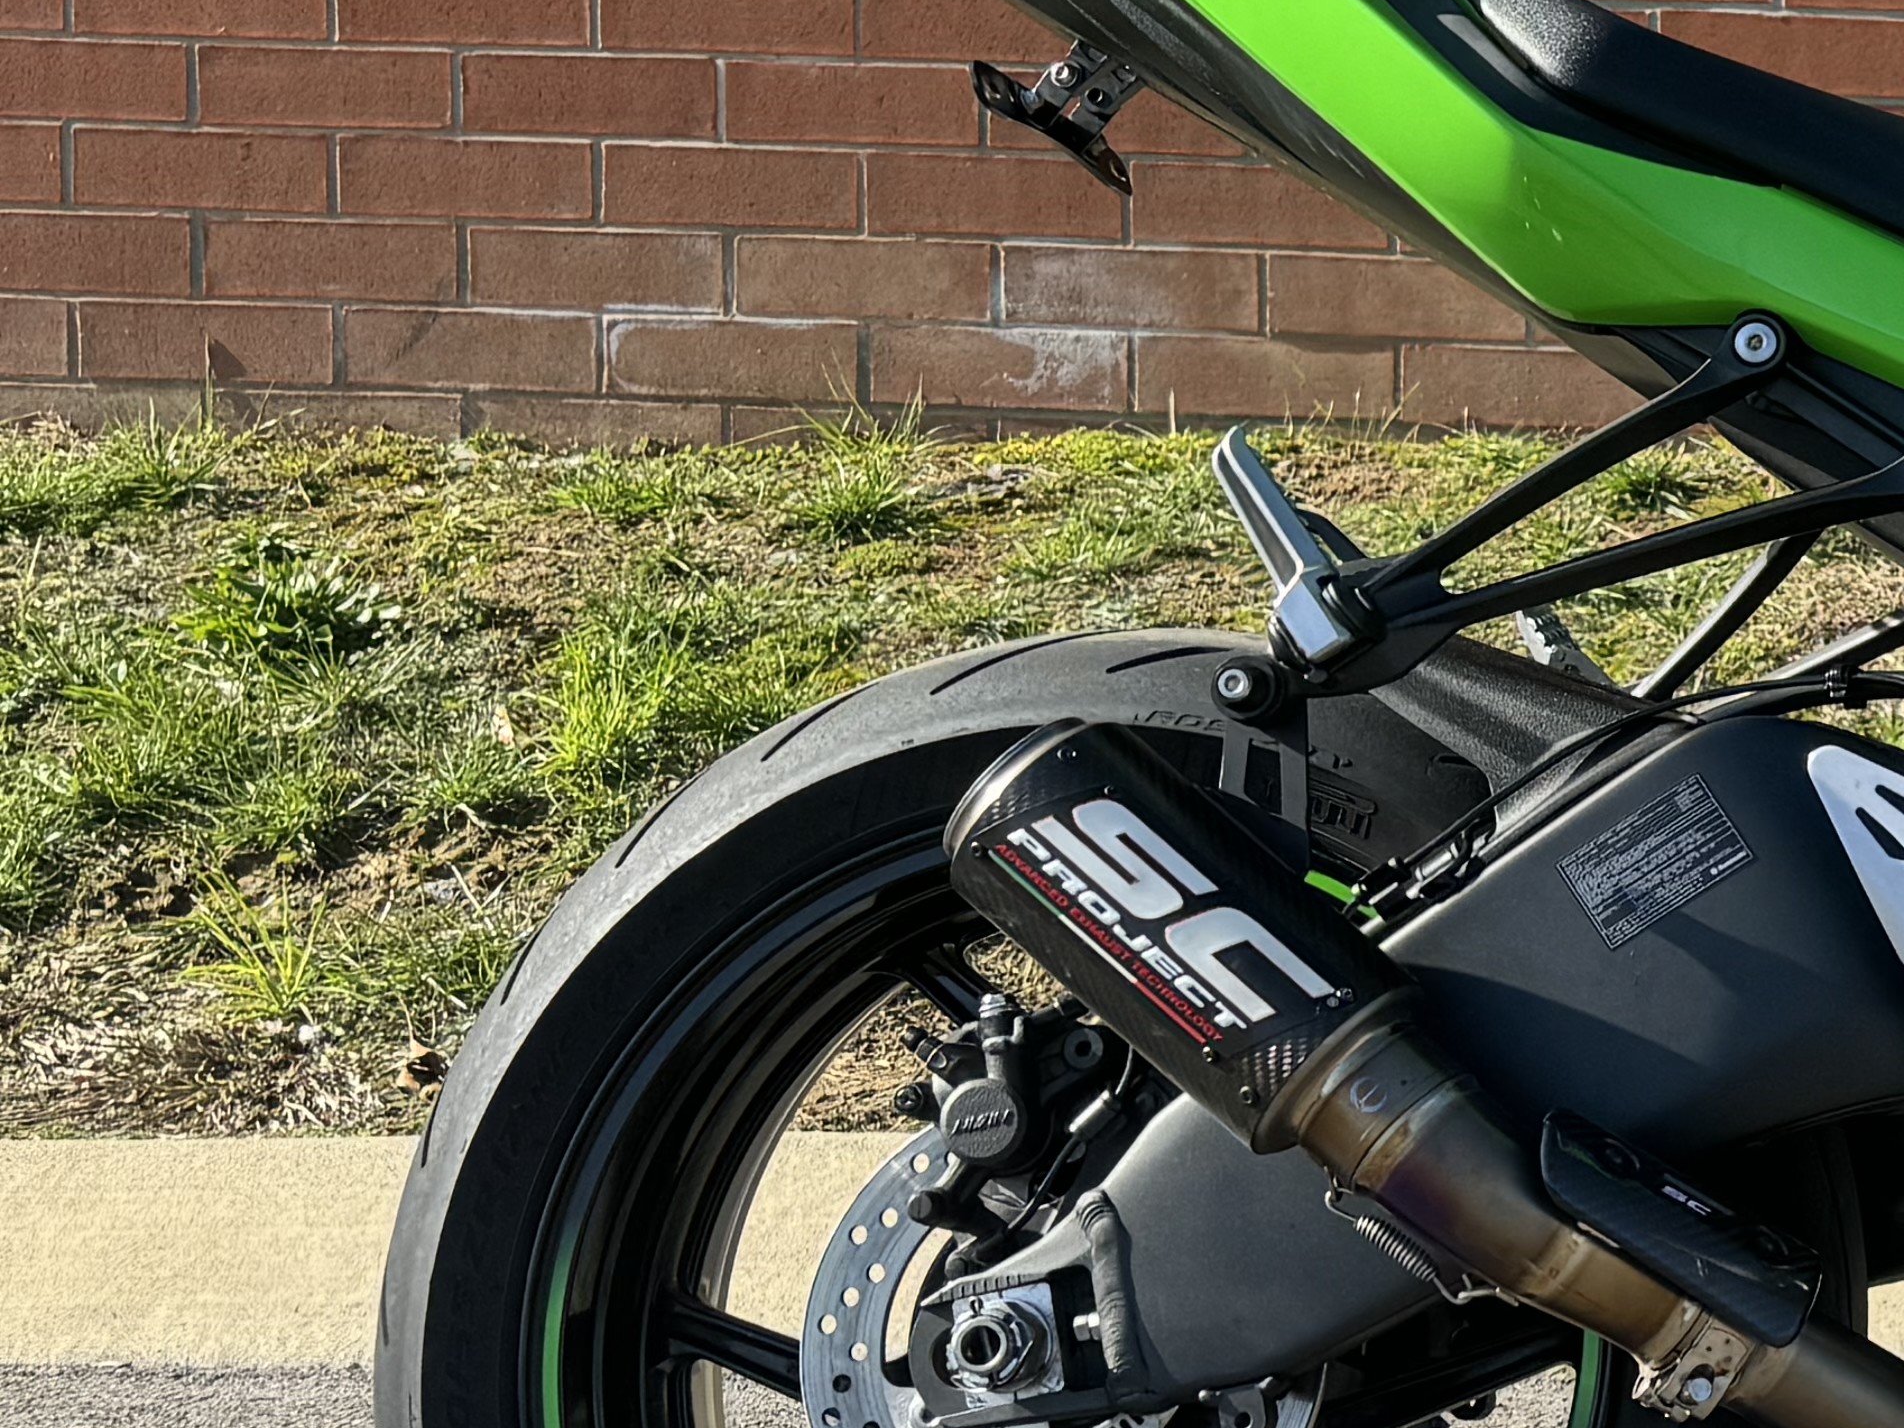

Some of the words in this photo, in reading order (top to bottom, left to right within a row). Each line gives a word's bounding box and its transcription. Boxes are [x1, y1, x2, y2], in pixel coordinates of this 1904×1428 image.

[995, 844, 1069, 908] ADVANCED
[1070, 906, 1131, 962] EXHAUST
[1131, 958, 1225, 1042] TECHNOLOGY
[1007, 828, 1247, 1029] PROJECT
[1031, 799, 1334, 1023] SC
